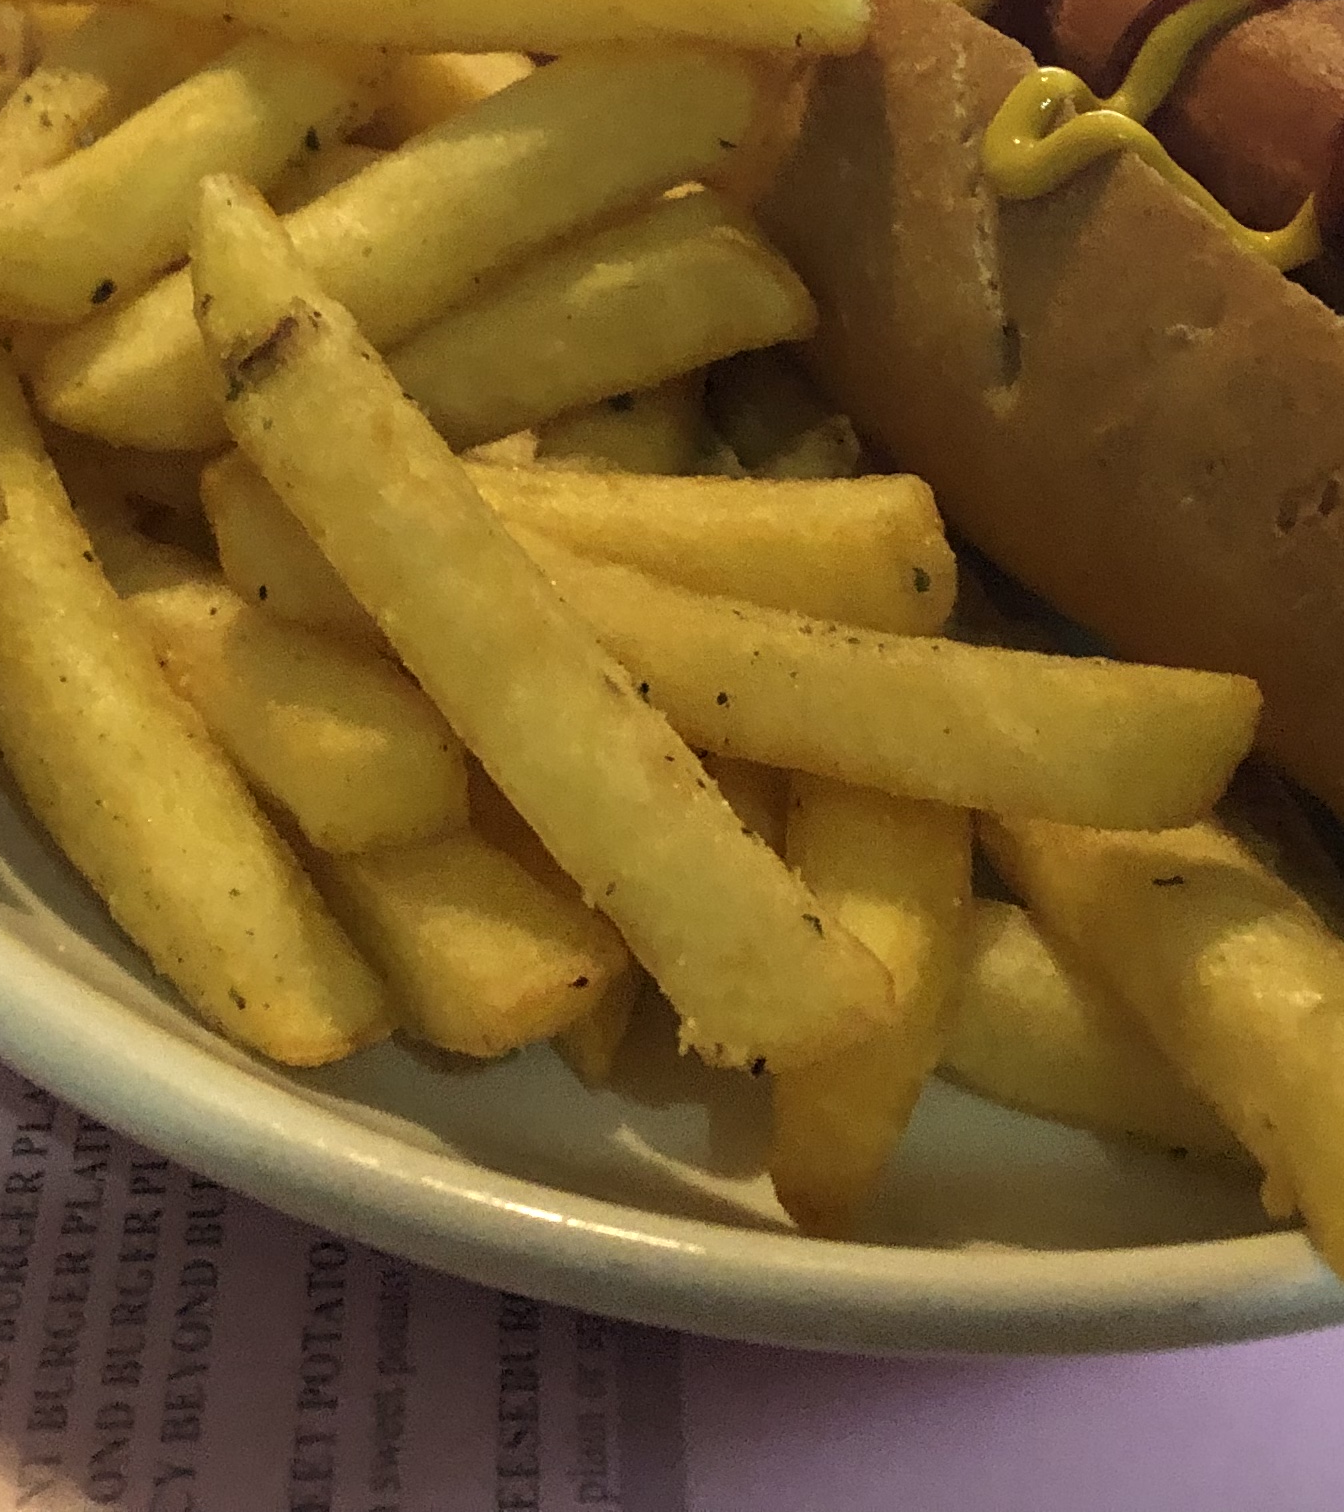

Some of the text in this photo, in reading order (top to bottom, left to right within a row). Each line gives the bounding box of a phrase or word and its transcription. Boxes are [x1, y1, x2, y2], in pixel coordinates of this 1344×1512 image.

[26, 1248, 96, 1430] BURGER
[101, 1207, 164, 1387] BURGER
[160, 1256, 219, 1443] BEYOND
[297, 1240, 348, 1410] POTATO
